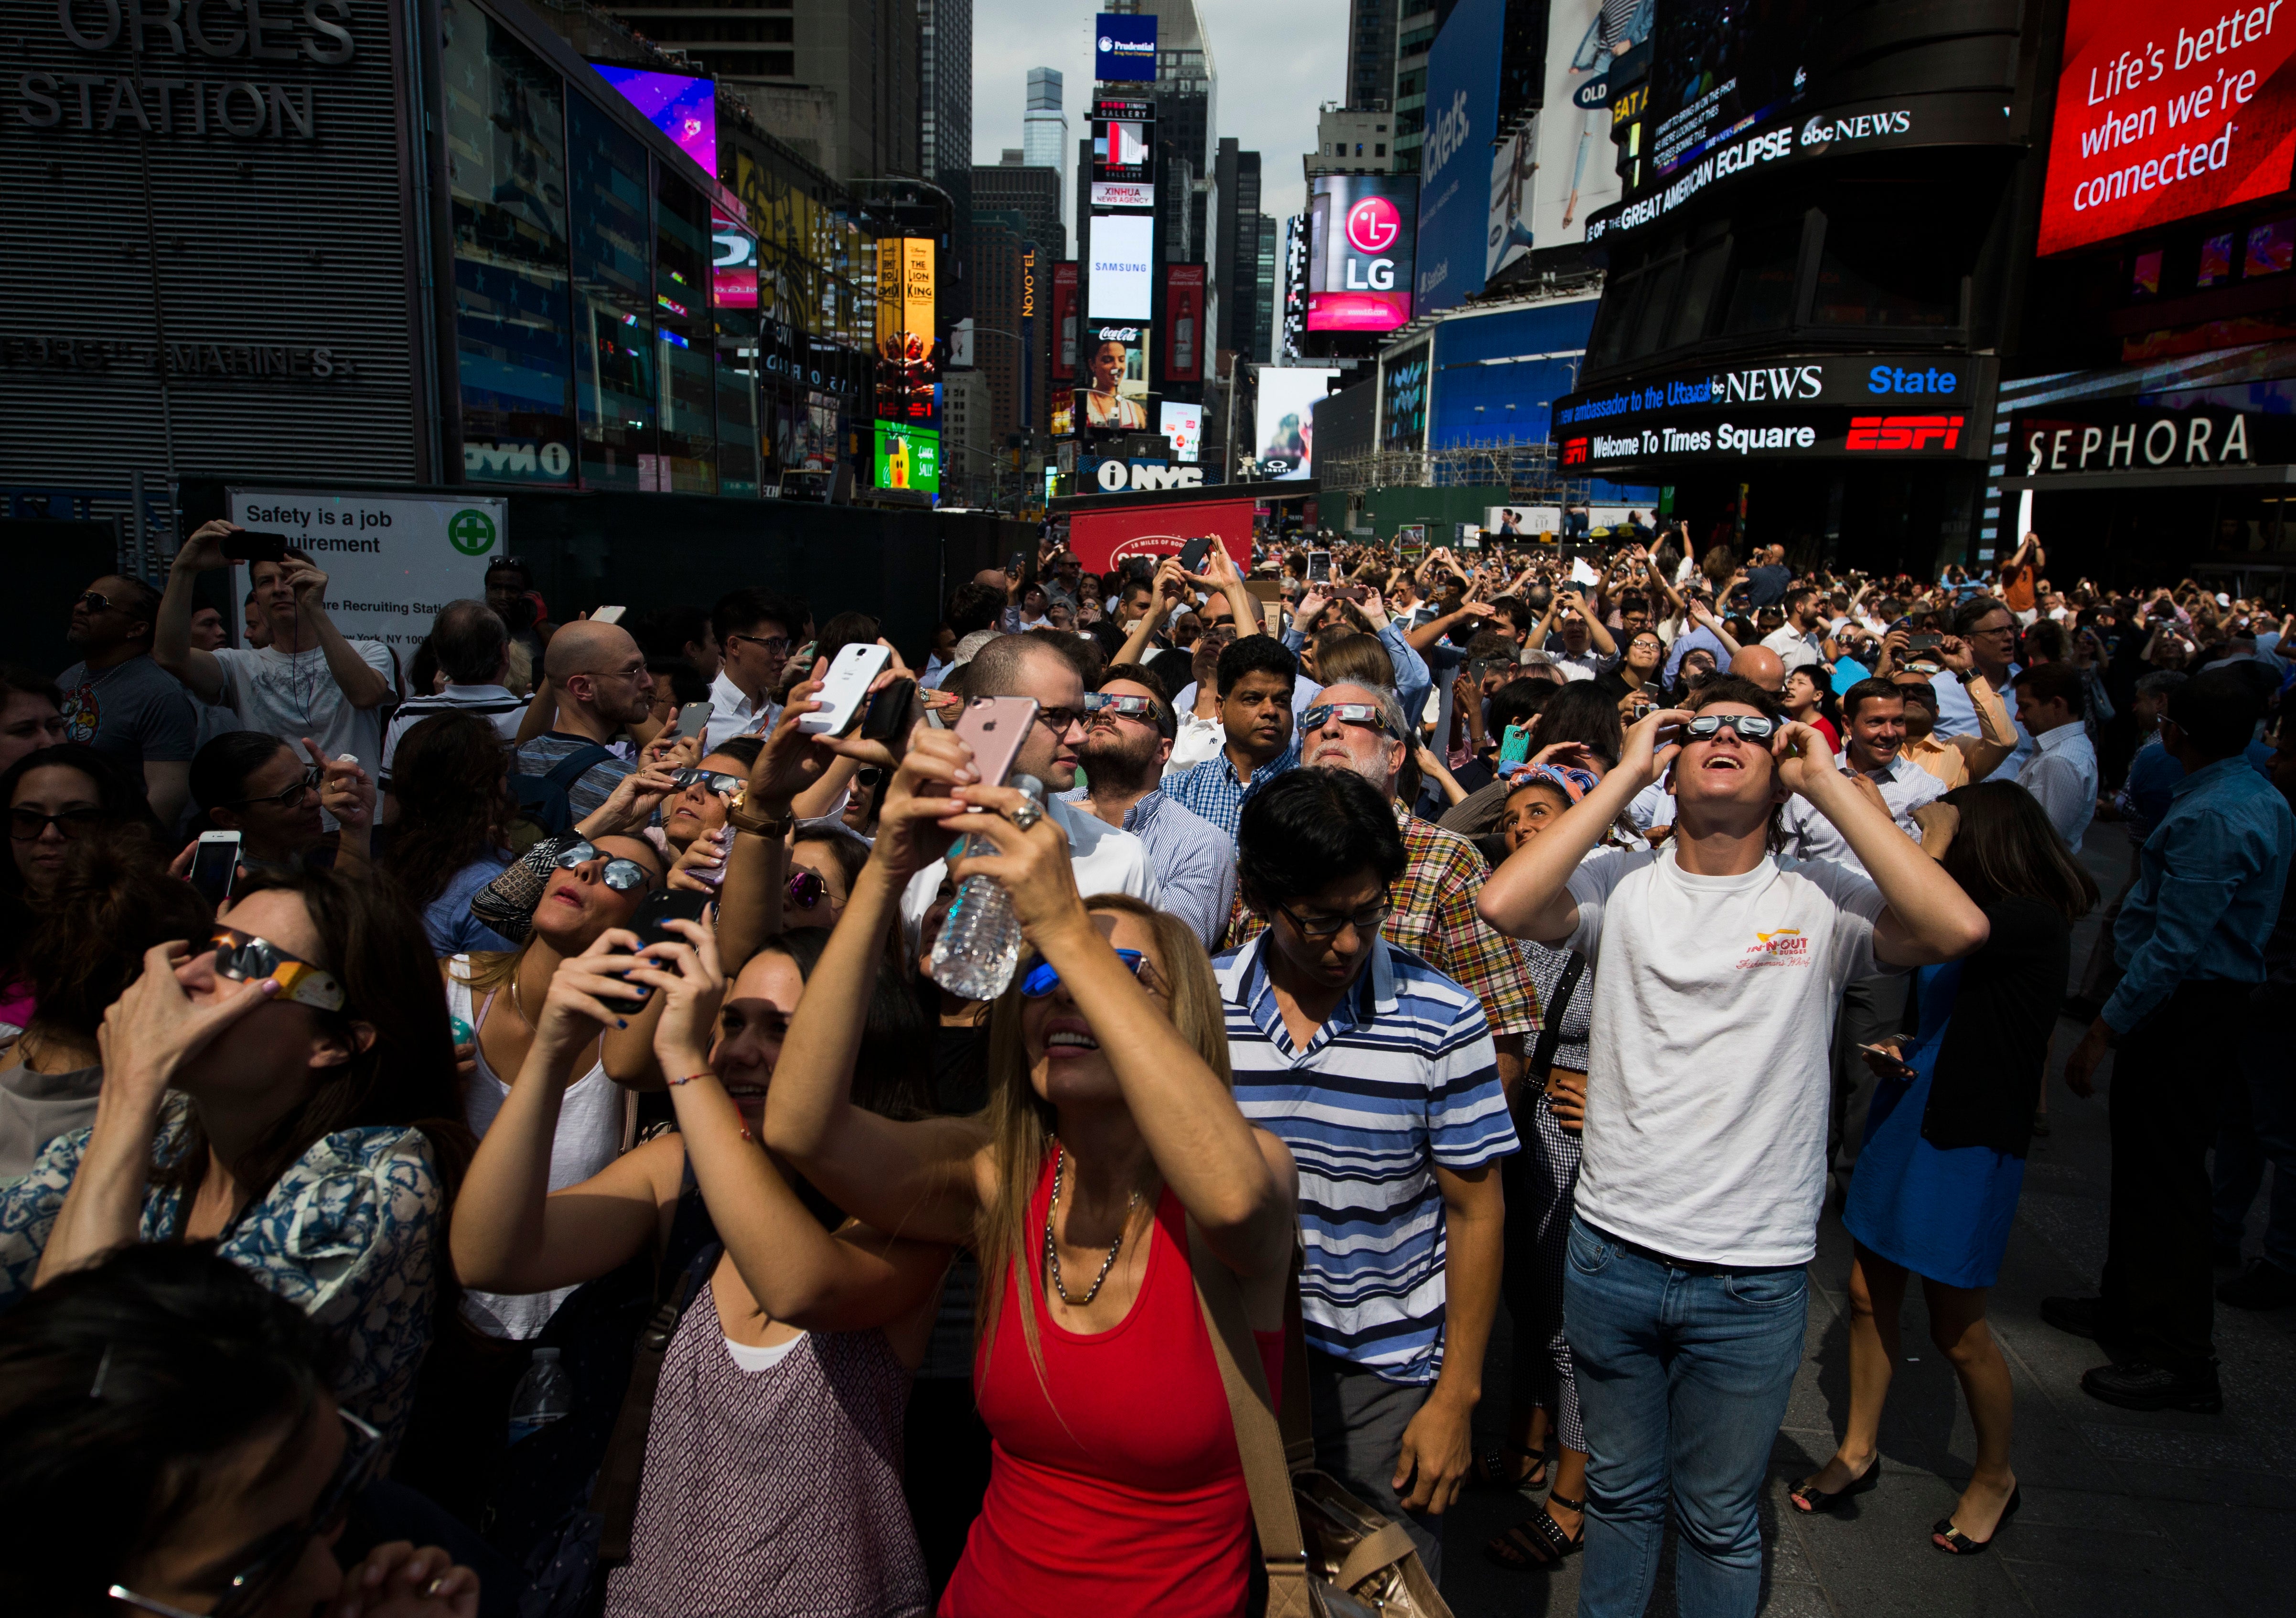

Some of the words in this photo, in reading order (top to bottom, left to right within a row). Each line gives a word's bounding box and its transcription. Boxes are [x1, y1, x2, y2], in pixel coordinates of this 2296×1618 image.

[1115, 41, 1154, 51] Prudential
[2088, 42, 2165, 106] Life's
[2175, 0, 2283, 70] better
[18, 71, 316, 139] STATION
[1581, 83, 1607, 103] OLD
[1101, 109, 1147, 118] GALLERY
[1613, 90, 1640, 125] EAT
[2081, 106, 2157, 159] when
[2168, 68, 2256, 129] we're
[1422, 90, 1470, 188] ickets,
[1593, 219, 1606, 239] OF
[1608, 216, 1621, 230] THE
[1621, 190, 1663, 230] GREAT
[1663, 162, 1713, 214] AMERICAN
[1716, 127, 1792, 178] ECLIPSE
[1801, 124, 1833, 145] abc
[1834, 110, 1910, 140] NEWS
[2073, 122, 2233, 212] connected
[1105, 187, 1140, 196] XINHUA
[1119, 196, 1149, 205] AGENCY
[909, 269, 929, 282] LION
[1095, 262, 1147, 272] SAMSUNG
[1346, 259, 1395, 290] LG
[907, 283, 932, 299] KING
[171, 344, 333, 378] MARINES
[1724, 365, 1822, 404] NEWS
[1868, 366, 1957, 395] State
[1574, 393, 1630, 422] ambassador
[1631, 390, 1642, 412] to
[1645, 386, 1664, 410] the
[1593, 435, 1639, 459] Welcome
[1642, 430, 1659, 454] To
[1663, 427, 1711, 453] Times
[1717, 423, 1815, 454] Square
[2028, 414, 2249, 471] SEPHORA
[1132, 464, 1202, 490] NYC
[247, 505, 311, 527] Safety
[318, 508, 335, 525] is
[342, 513, 353, 526] a
[360, 510, 392, 530] job
[343, 600, 409, 615] Recruiting
[413, 603, 441, 614] Stati
[386, 635, 402, 643] NY
[1746, 938, 1809, 953] IN-N-OUT
[1736, 958, 1785, 970] Fisherman's
[1787, 956, 1811, 968] Wharf
